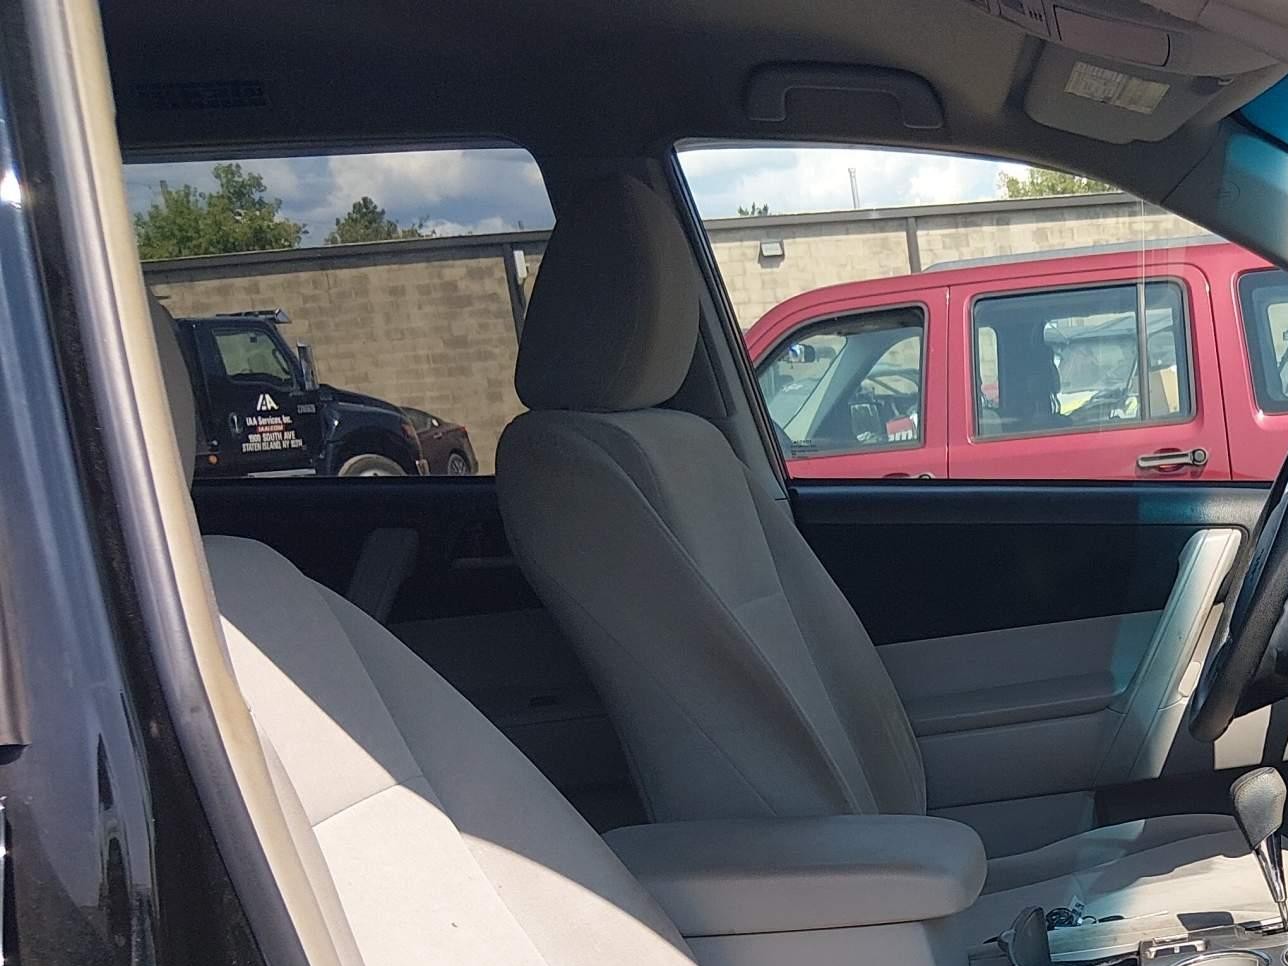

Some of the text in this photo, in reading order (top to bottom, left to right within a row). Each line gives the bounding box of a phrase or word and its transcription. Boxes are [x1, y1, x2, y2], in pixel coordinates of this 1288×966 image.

[246, 414, 292, 426] IAA Services, Inc.
[262, 432, 282, 441] SOUTH
[283, 431, 295, 440] AVE
[242, 442, 261, 452] STATEN
[282, 440, 290, 448] NY
